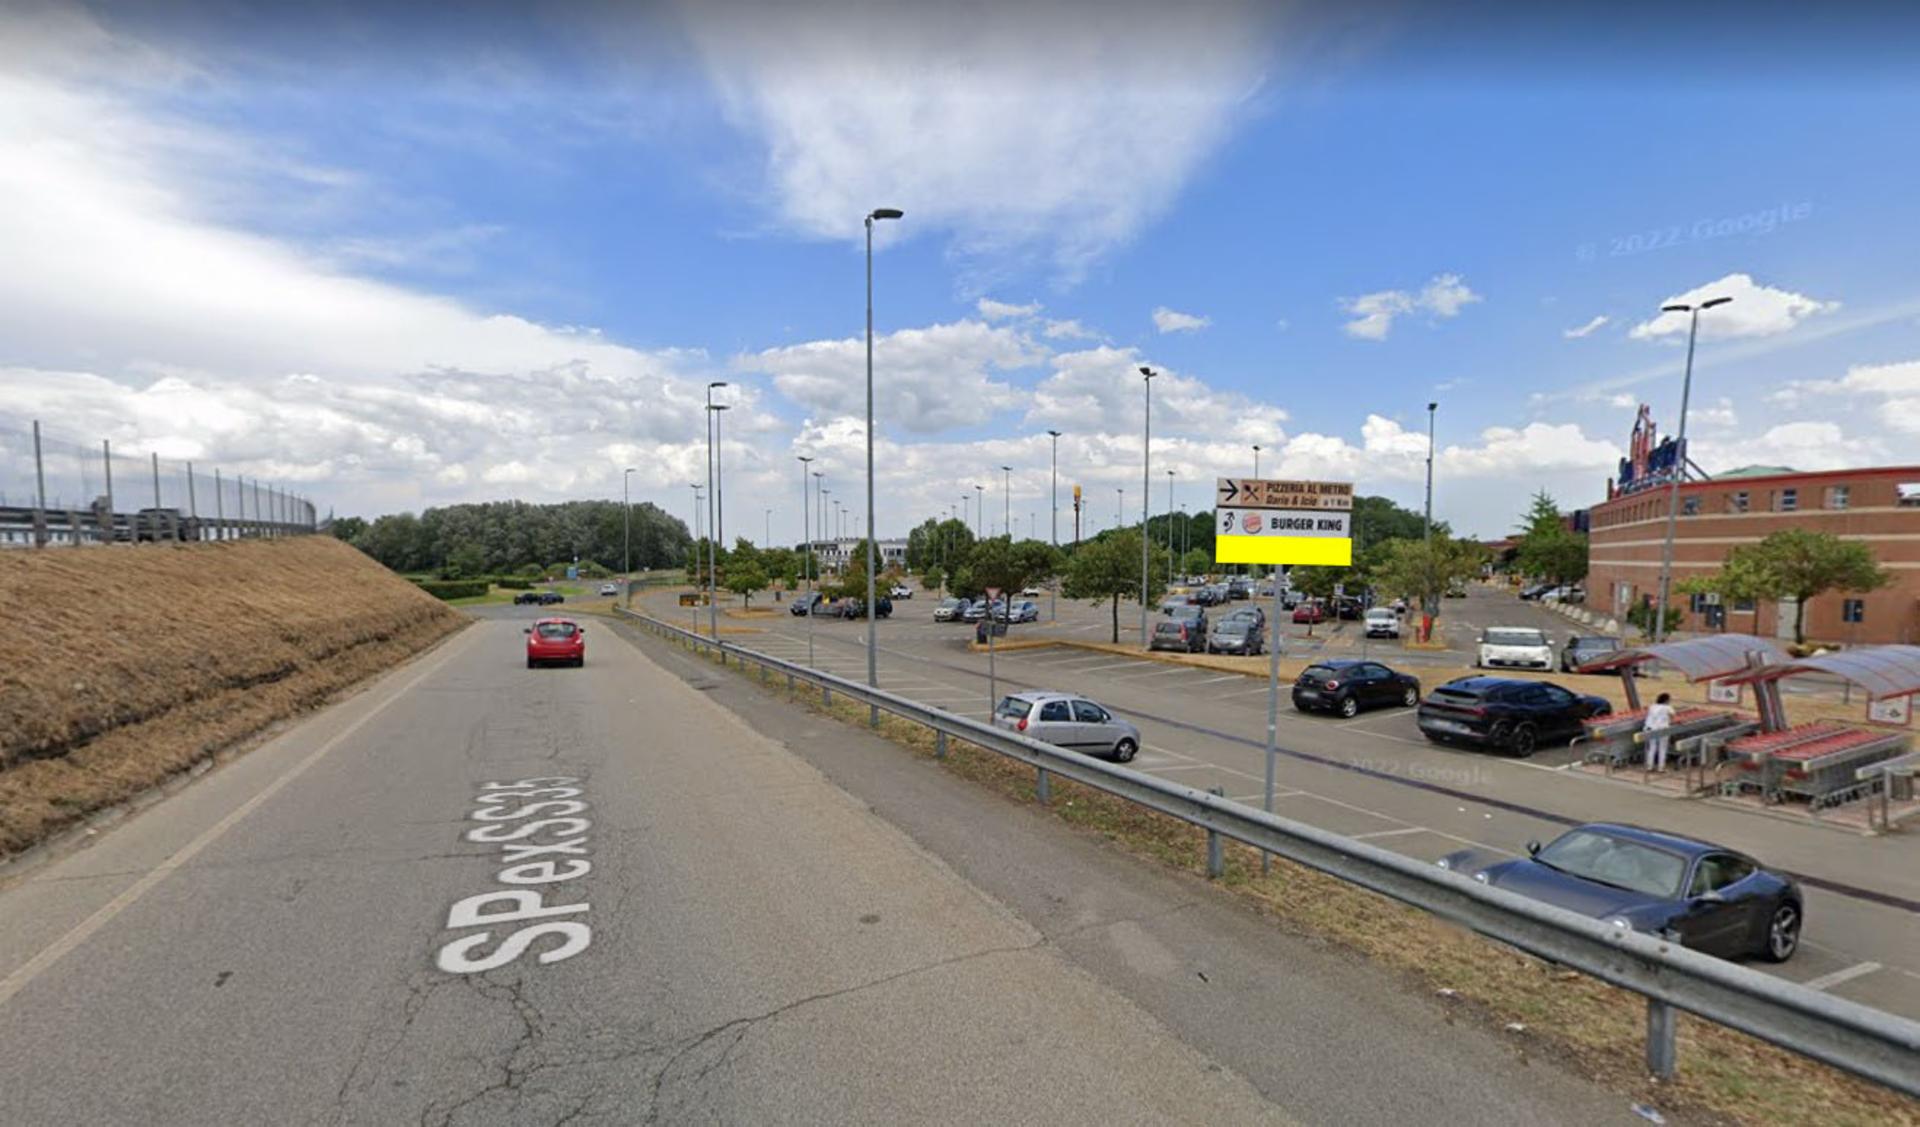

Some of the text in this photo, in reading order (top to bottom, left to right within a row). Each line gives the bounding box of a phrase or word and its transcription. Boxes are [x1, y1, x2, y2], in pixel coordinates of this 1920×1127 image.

[1266, 482, 1350, 496] PIZZERIA AL METRO
[1271, 517, 1314, 531] BURGER
[1317, 519, 1342, 532] KING
